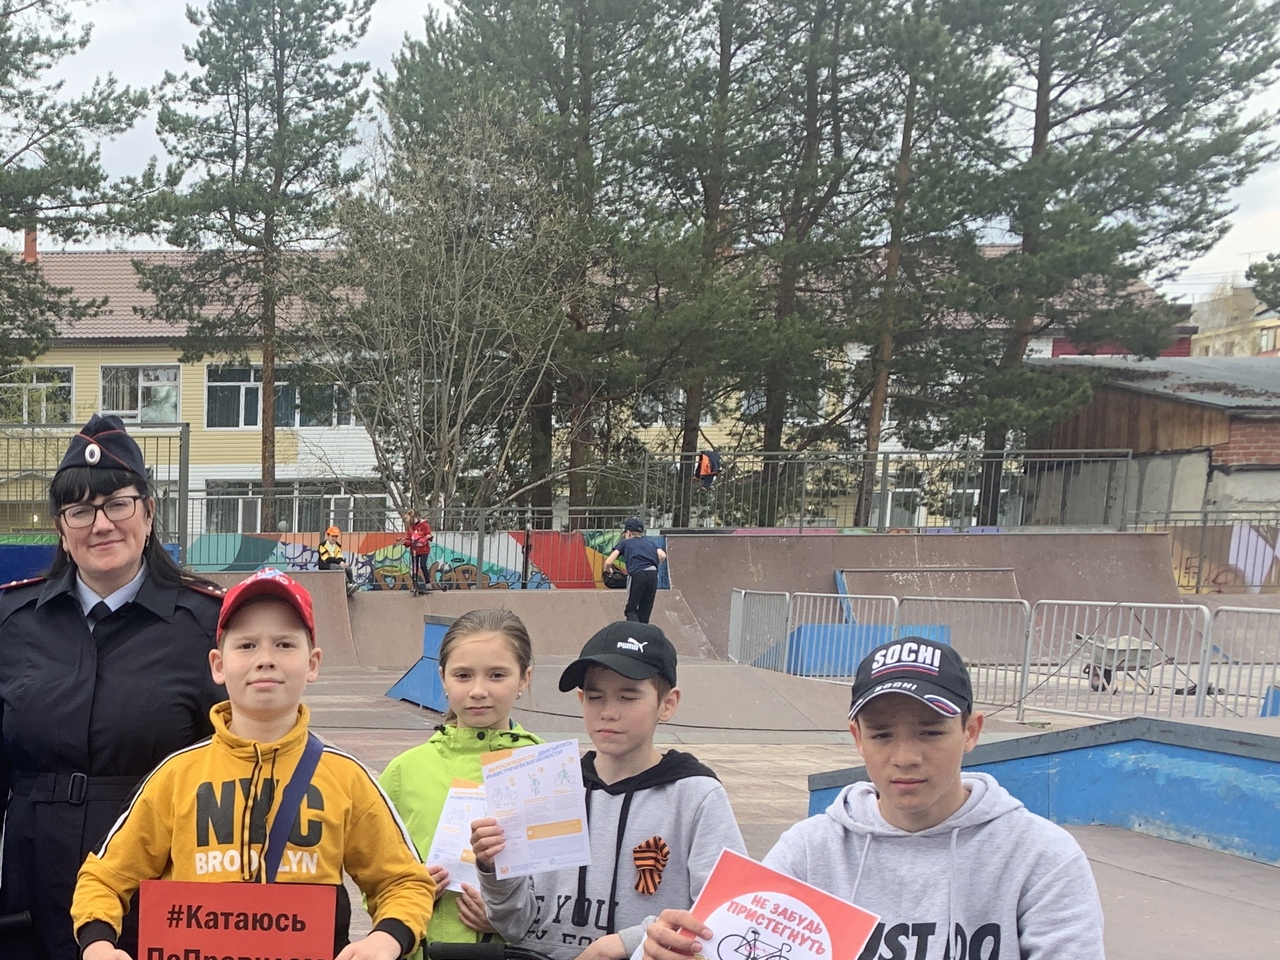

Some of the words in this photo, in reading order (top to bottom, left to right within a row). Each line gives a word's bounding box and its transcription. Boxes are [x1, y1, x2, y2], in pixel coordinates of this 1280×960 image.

[616, 641, 639, 651] PUMA
[871, 642, 941, 670] SOCHI
[873, 681, 918, 693] SOCHI
[166, 904, 307, 933] #Катаюсь
[726, 900, 826, 956] ПРИСТЕГНУТЬ
[750, 894, 770, 910] НЕ
[769, 903, 824, 935] ЗАБУДЬ
